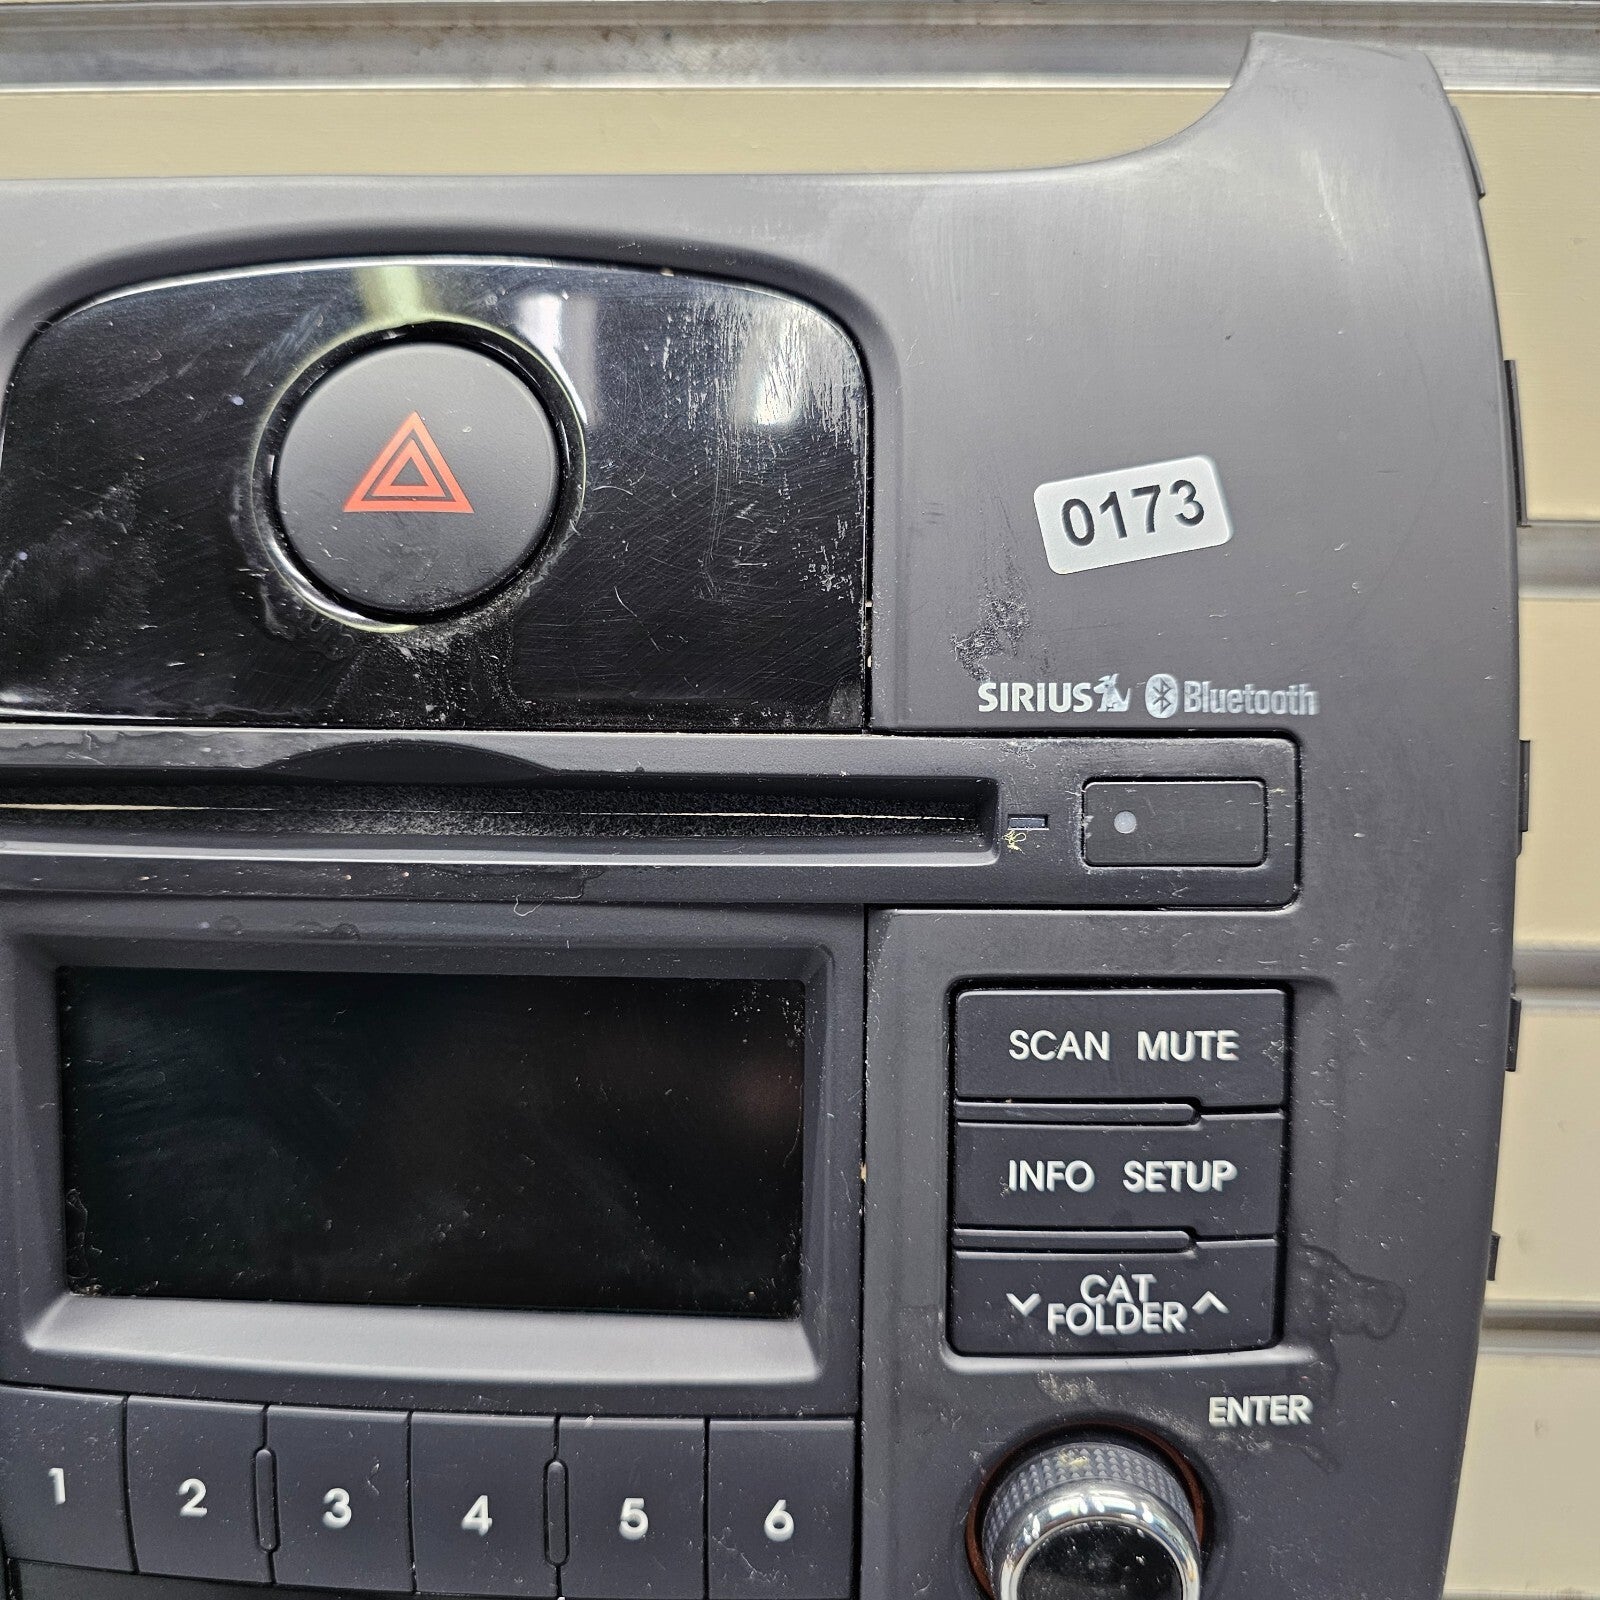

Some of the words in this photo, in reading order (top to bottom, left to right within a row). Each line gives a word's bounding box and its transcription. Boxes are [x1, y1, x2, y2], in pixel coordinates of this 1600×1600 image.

[1061, 480, 1205, 547] 0173
[977, 682, 1094, 713] SIRIUS
[1183, 680, 1321, 716] Bluetooth
[1008, 1030, 1110, 1061] SCAN
[1137, 1030, 1239, 1061] MUTE
[1008, 1160, 1095, 1192] INFO
[1122, 1160, 1238, 1193] SETUP
[1080, 1274, 1157, 1304] CAT
[1047, 1302, 1188, 1335] FOLDER
[1208, 1395, 1313, 1427] ENTER
[49, 1467, 66, 1505] 1
[179, 1478, 208, 1518] 2
[322, 1488, 353, 1529] 3
[462, 1494, 493, 1535] 4
[618, 1497, 650, 1541] 5
[763, 1499, 795, 1542] 6
